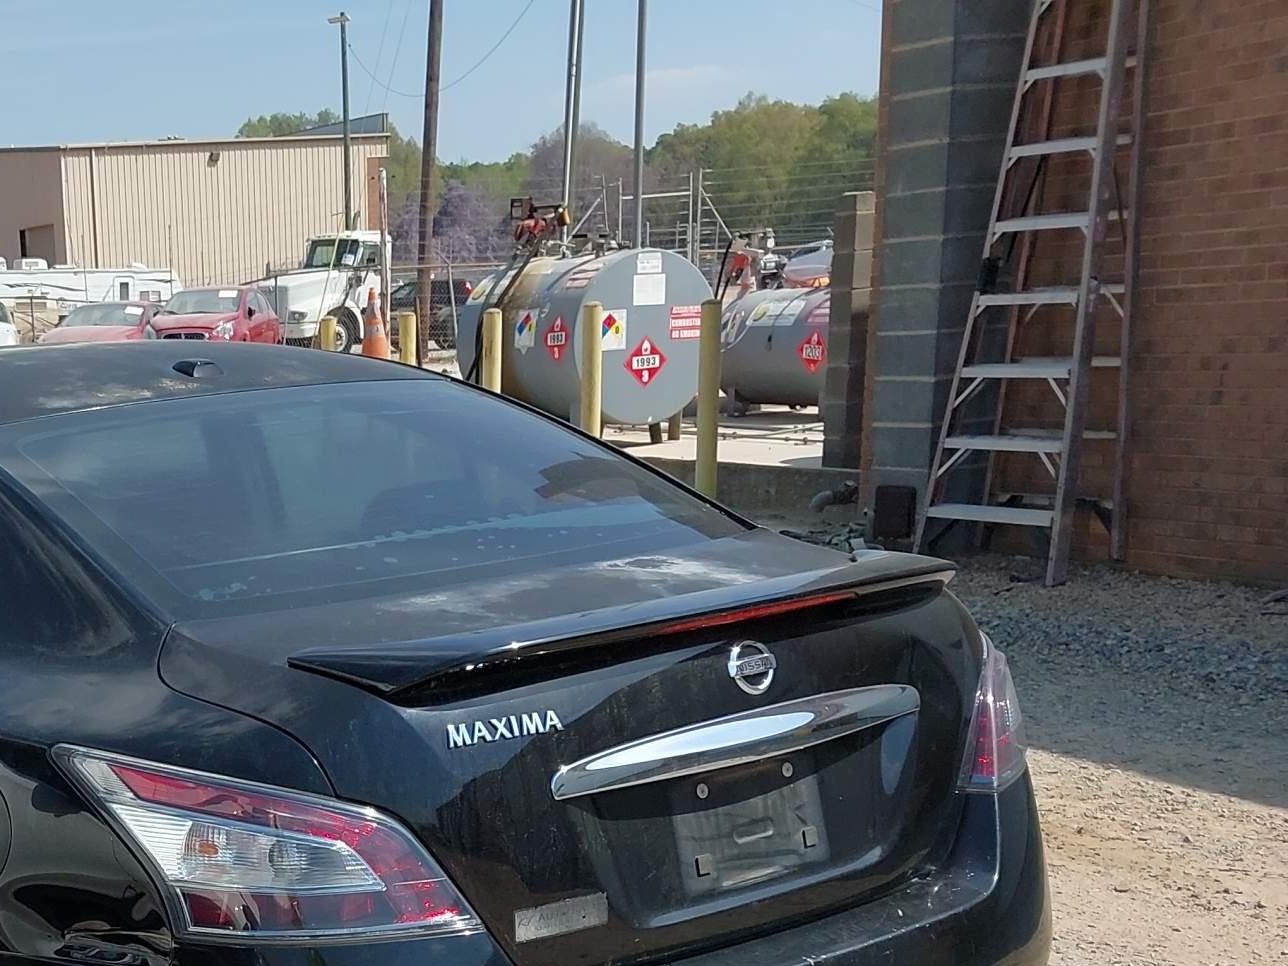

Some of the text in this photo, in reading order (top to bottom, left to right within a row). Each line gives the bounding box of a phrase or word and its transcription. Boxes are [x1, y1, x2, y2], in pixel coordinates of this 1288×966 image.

[636, 356, 656, 368] 1993
[641, 369, 650, 383] 3
[447, 709, 565, 749] MAXIMA
